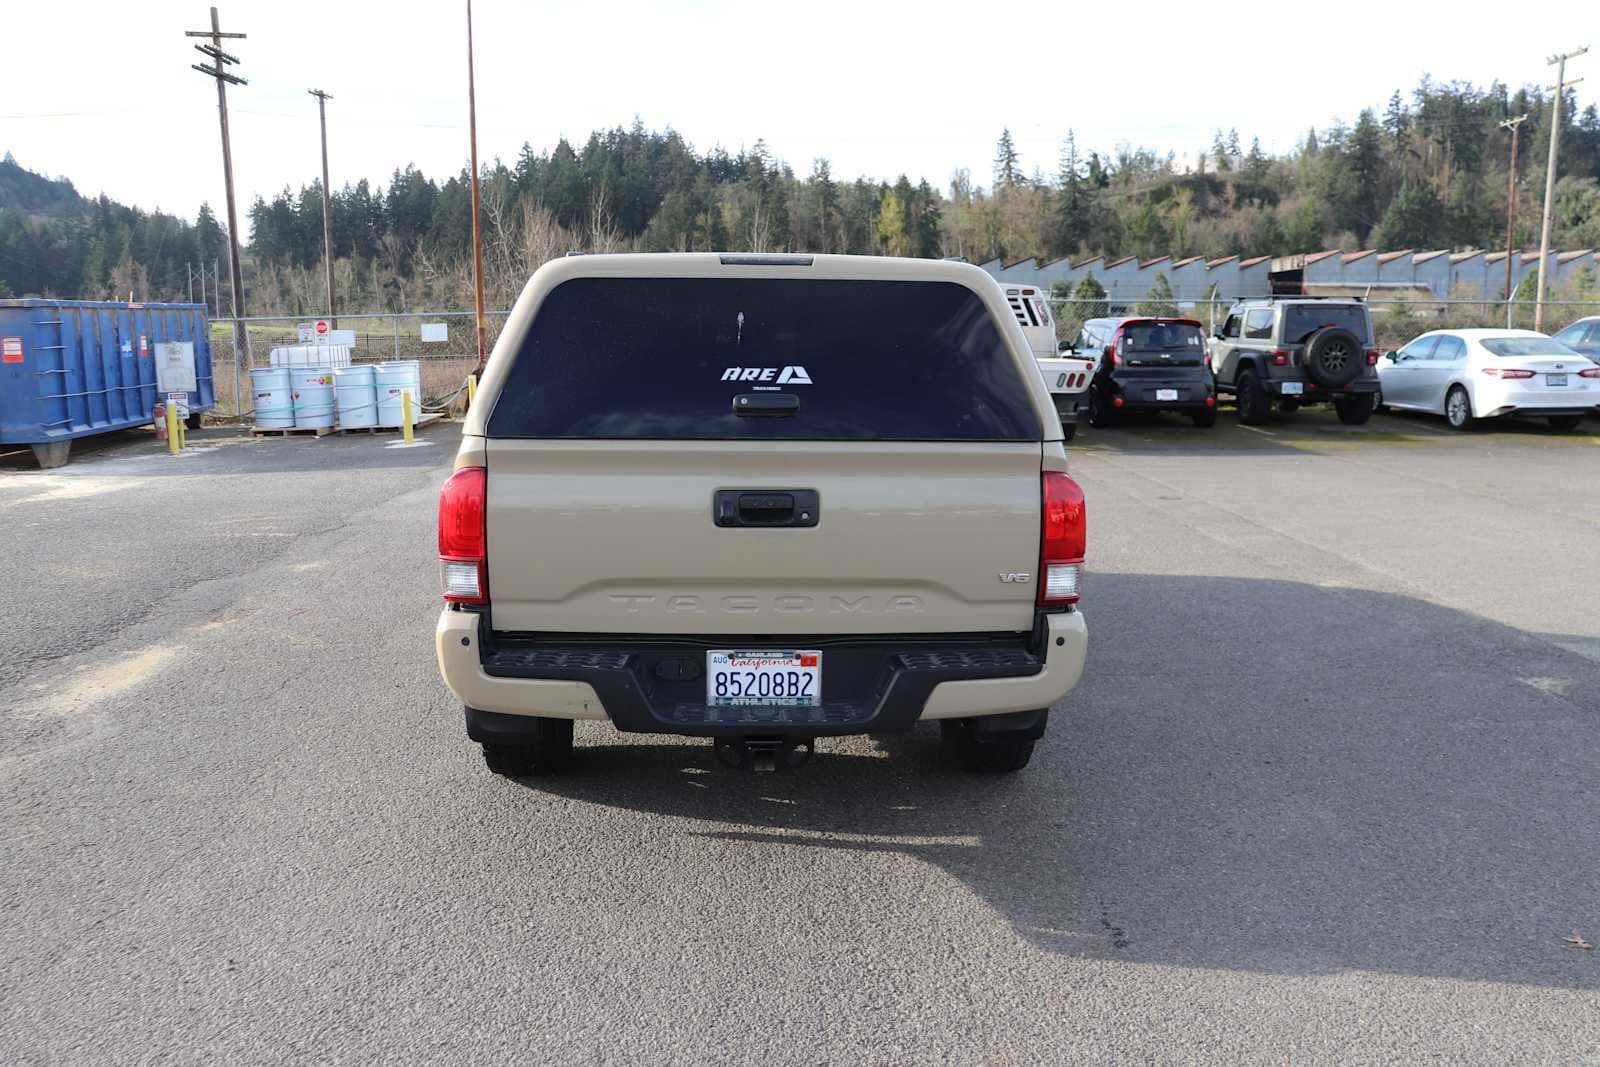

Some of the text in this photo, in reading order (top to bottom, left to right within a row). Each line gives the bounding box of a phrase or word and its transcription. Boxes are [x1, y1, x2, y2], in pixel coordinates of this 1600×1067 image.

[999, 572, 1031, 583] V6
[608, 593, 926, 615] TACOMA
[712, 656, 728, 664] AUG
[730, 657, 799, 670] California
[715, 672, 813, 697] 85208B2
[730, 698, 797, 706] ATHLETICS
